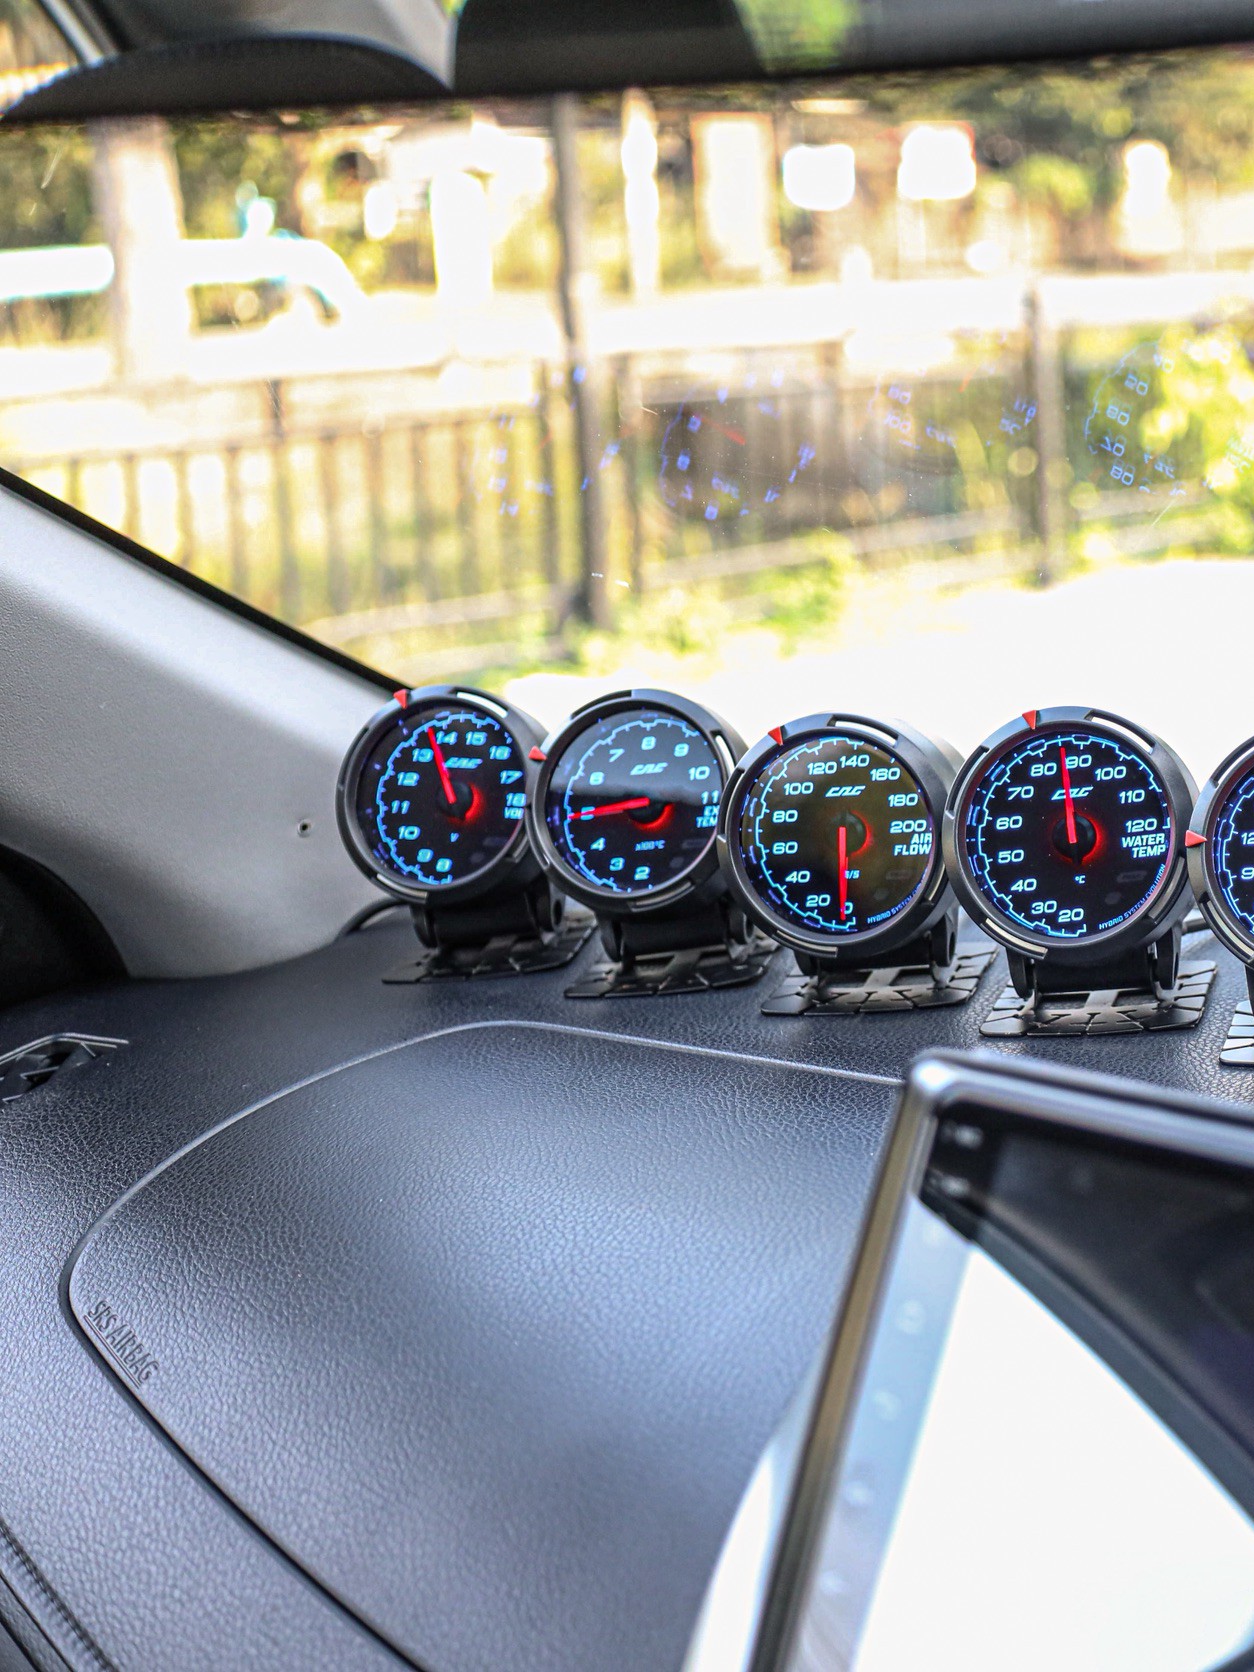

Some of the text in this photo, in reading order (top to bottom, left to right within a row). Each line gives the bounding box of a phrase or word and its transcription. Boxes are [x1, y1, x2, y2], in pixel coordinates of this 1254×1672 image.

[436, 731, 458, 745] 14
[466, 731, 487, 746] 15
[641, 736, 656, 750] 8
[412, 748, 434, 762] 13
[489, 746, 511, 760] 16
[609, 748, 625, 762] 7
[840, 754, 870, 768] 140
[1065, 755, 1092, 769] 90
[688, 766, 710, 780] 10
[807, 762, 837, 775] 120
[870, 768, 900, 781] 160
[1030, 762, 1057, 777] 80
[1095, 766, 1126, 781] 100
[398, 772, 420, 786] 12
[500, 770, 523, 784] 17
[589, 772, 604, 786] 6
[784, 782, 814, 795] 100
[1007, 786, 1034, 800] 70
[701, 790, 719, 804] 11
[888, 794, 918, 807] 180
[1120, 789, 1146, 804] 110
[391, 800, 410, 814] 11
[772, 810, 798, 823] 80
[996, 816, 1022, 830] 60
[890, 820, 926, 834] 200
[1126, 818, 1157, 832] 120
[398, 826, 420, 840] 10
[910, 833, 932, 844] AIR
[590, 838, 606, 851] 4
[1122, 833, 1165, 848] WATER
[416, 848, 434, 862] 9
[772, 842, 798, 854] 60
[894, 844, 932, 856] FLOW
[1132, 845, 1166, 858] TEMP
[610, 857, 625, 871] 3
[998, 850, 1024, 864] 50
[436, 858, 452, 872] 8
[634, 866, 650, 880] 2
[785, 870, 810, 883] 40
[1011, 878, 1037, 892] 40
[806, 894, 830, 908] 20
[1031, 900, 1058, 914] 30
[1058, 908, 1084, 922] 20
[88, 1300, 160, 1384] SRS AIRBAG
